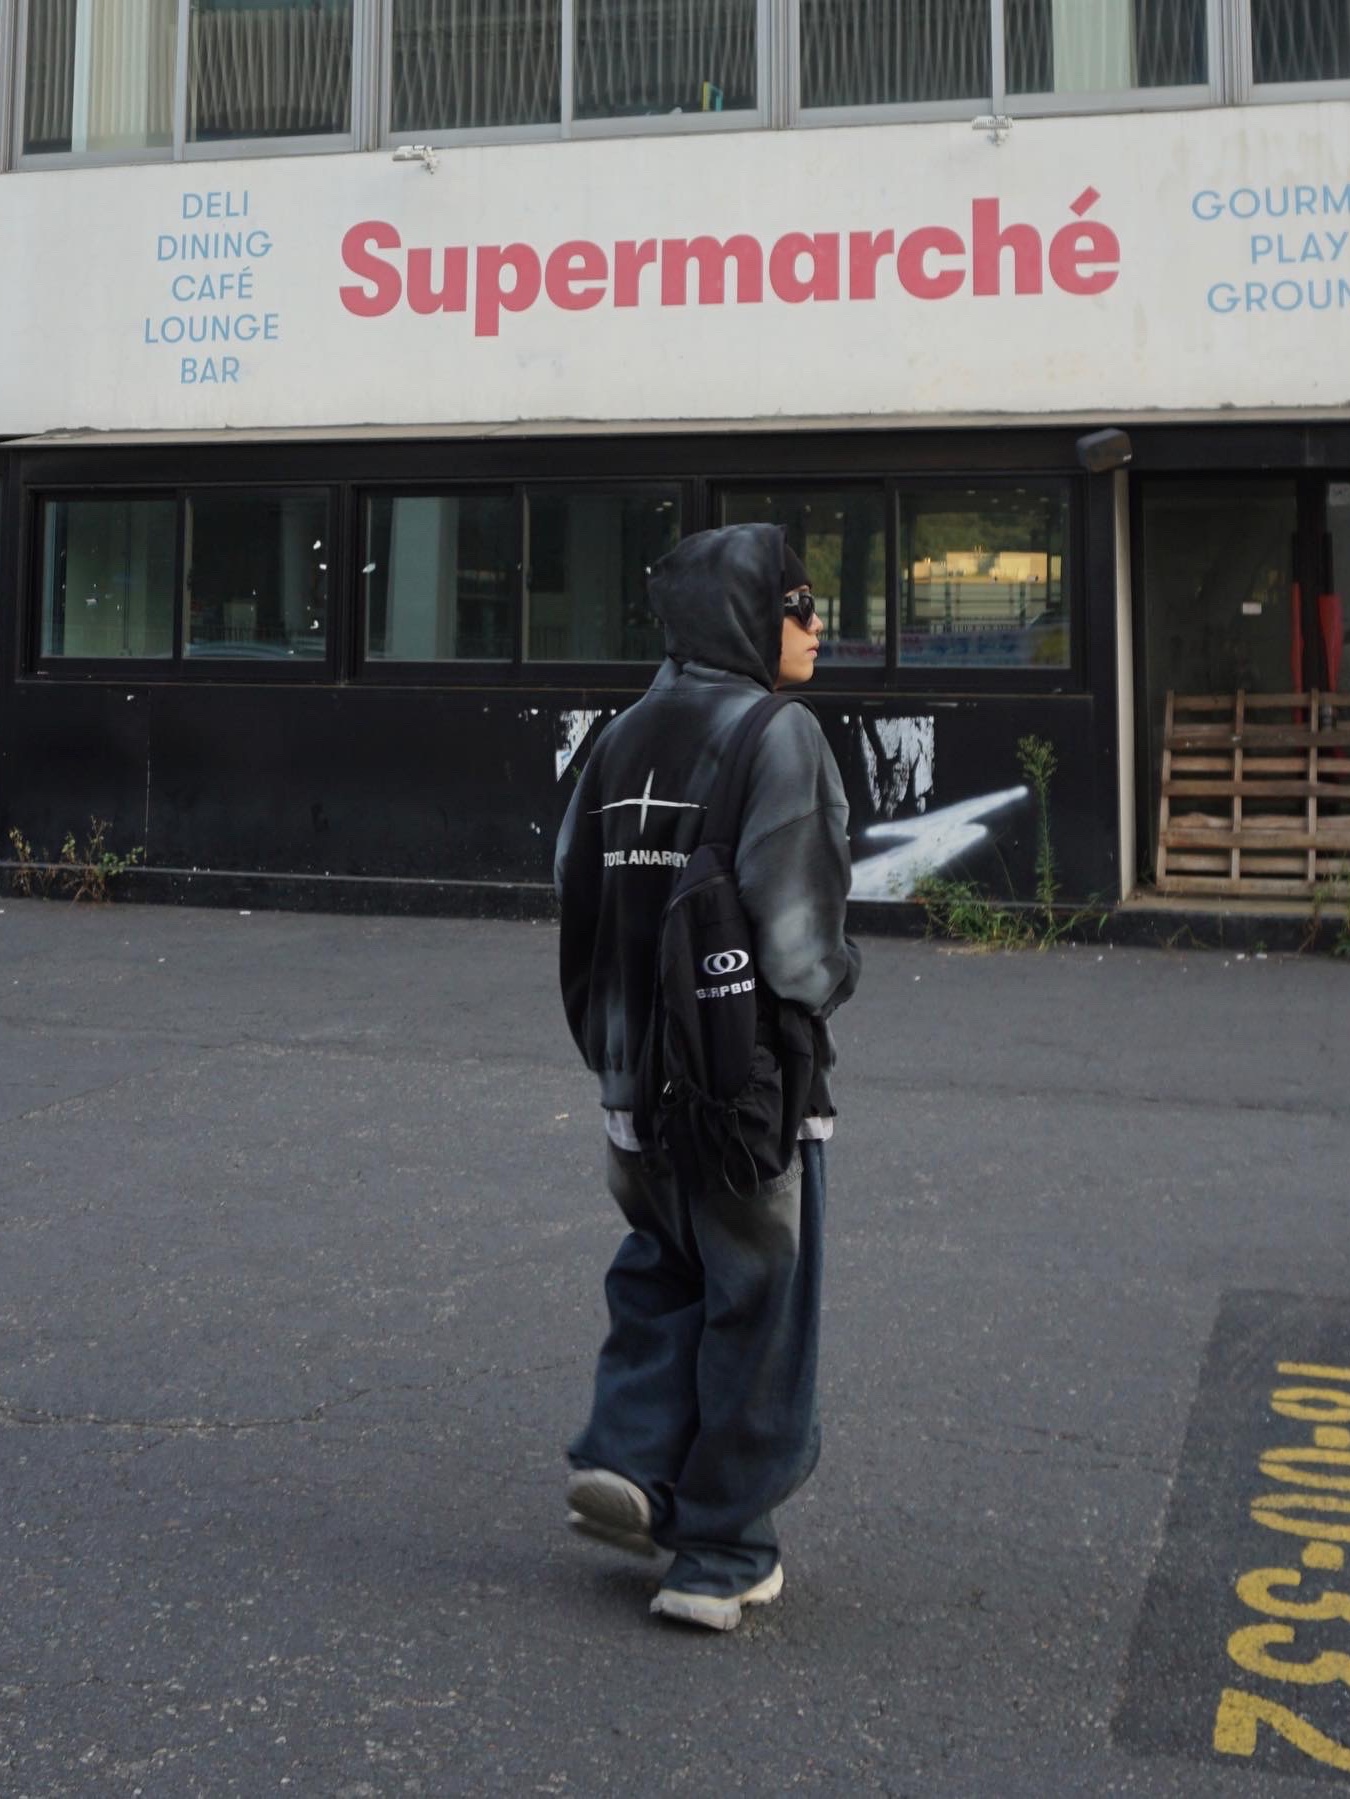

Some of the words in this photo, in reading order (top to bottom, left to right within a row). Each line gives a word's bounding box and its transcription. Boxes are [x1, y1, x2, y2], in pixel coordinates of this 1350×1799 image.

[182, 190, 249, 220] DELI
[1191, 183, 1350, 221] GOURM
[156, 229, 273, 262] DINING
[340, 185, 1120, 336] Supermarché
[1250, 231, 1349, 265] PLAY
[170, 265, 254, 302] CAFÉ
[143, 312, 279, 344] LOUNGE
[180, 356, 241, 385] BAR
[603, 850, 627, 868] TOTL
